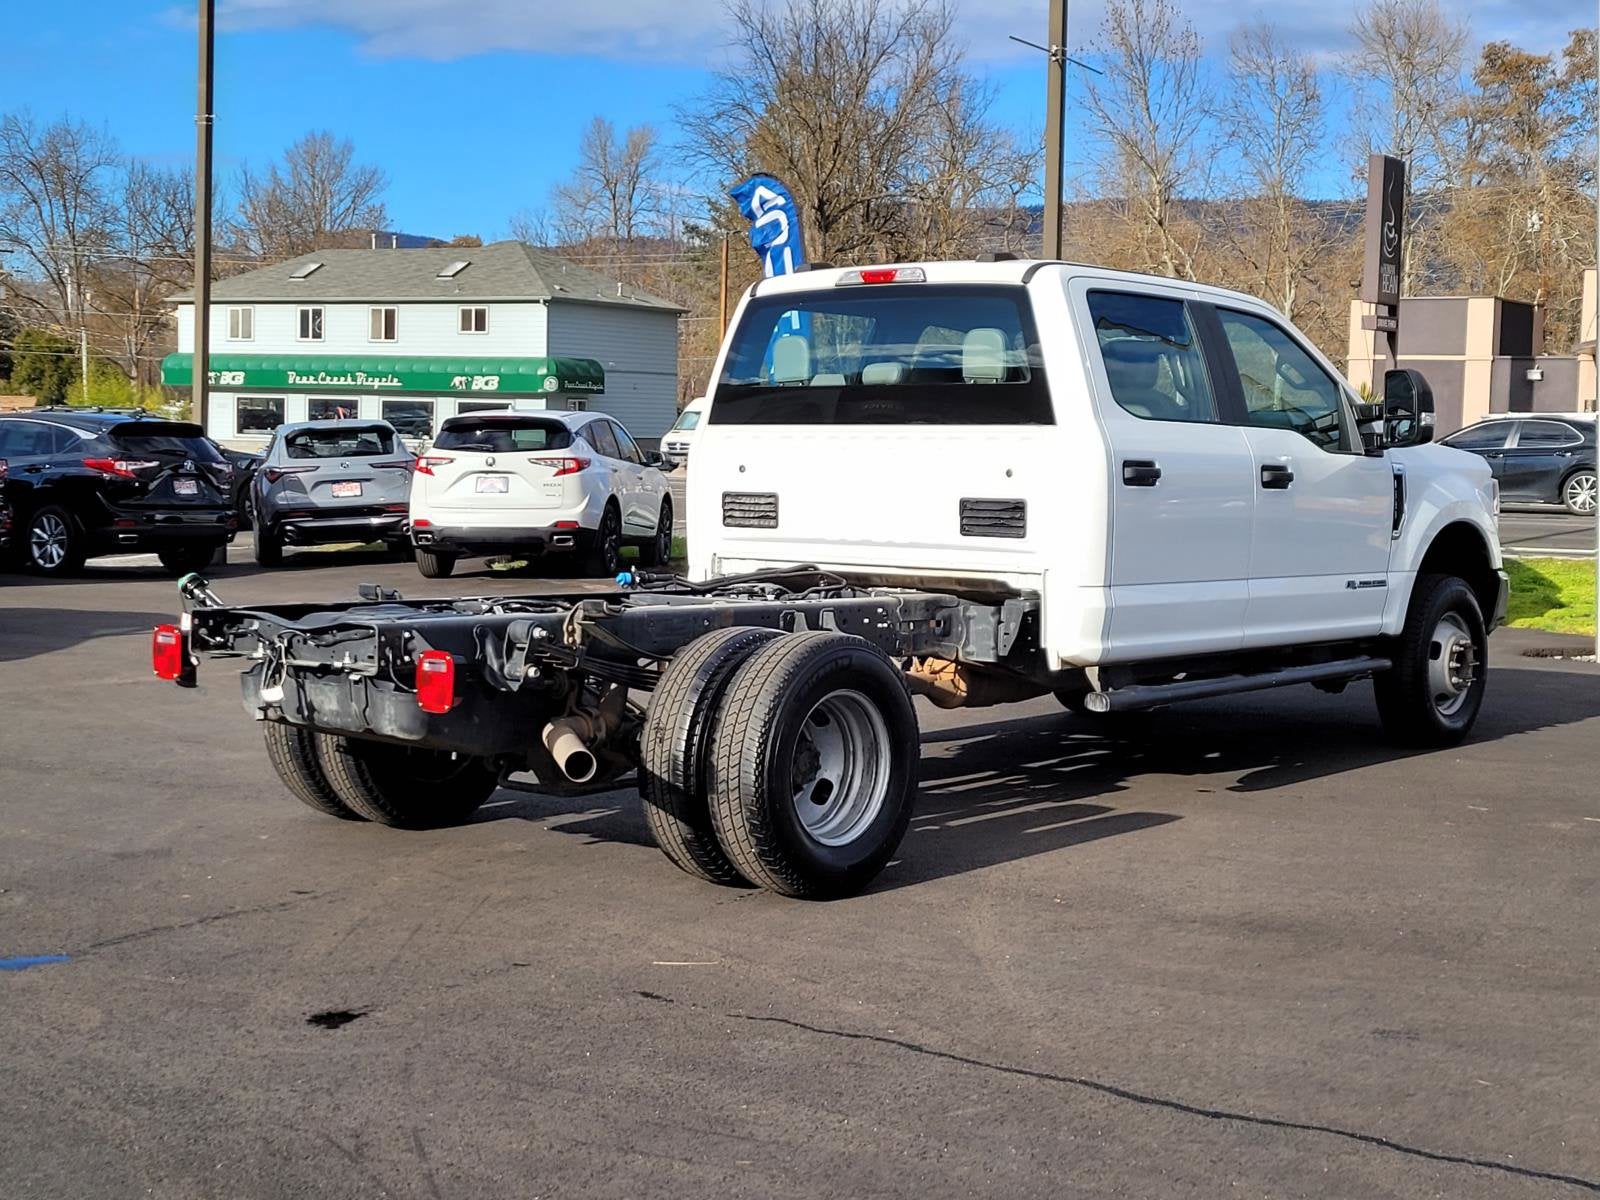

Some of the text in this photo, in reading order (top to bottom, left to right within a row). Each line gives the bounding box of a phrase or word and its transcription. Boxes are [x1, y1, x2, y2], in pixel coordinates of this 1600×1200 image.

[287, 371, 403, 389] Bear Creek Bicycle
